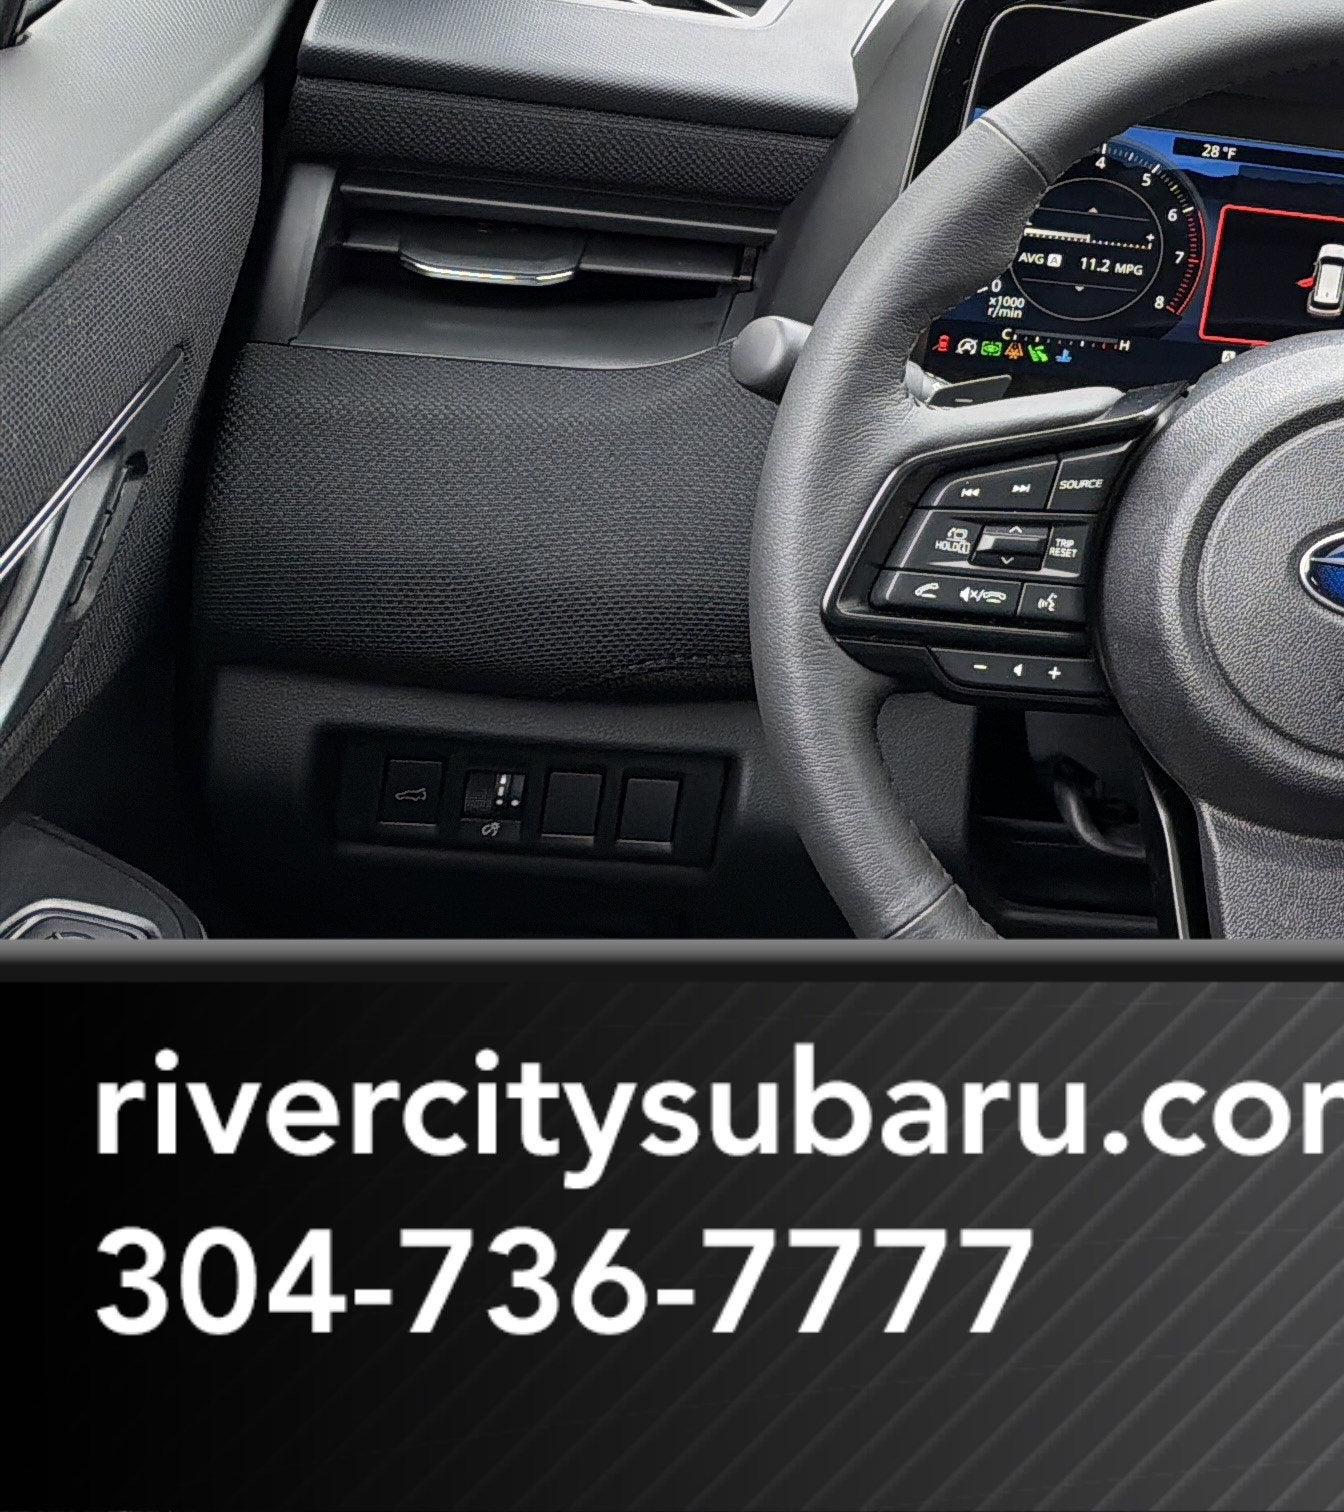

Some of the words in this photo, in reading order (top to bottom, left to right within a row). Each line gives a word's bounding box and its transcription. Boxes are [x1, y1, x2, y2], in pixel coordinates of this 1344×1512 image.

[1201, 143, 1220, 158] 28
[1094, 157, 1106, 170] 4
[1141, 173, 1152, 187] 5
[1167, 208, 1178, 222] 6
[1018, 251, 1045, 265] AVG
[1080, 257, 1110, 273] 11.2
[1114, 262, 1144, 276] MPG
[1173, 251, 1186, 265] 7
[991, 279, 1002, 293] 0
[988, 295, 1026, 309] x1000
[1154, 296, 1165, 310] 8
[986, 306, 1023, 319] r/min
[1001, 328, 1012, 341] C
[1118, 339, 1131, 352] H
[1058, 478, 1104, 491] SOURCE
[934, 540, 959, 554] HOLD
[1055, 538, 1076, 548] TRIP
[1049, 547, 1078, 559] RESET
